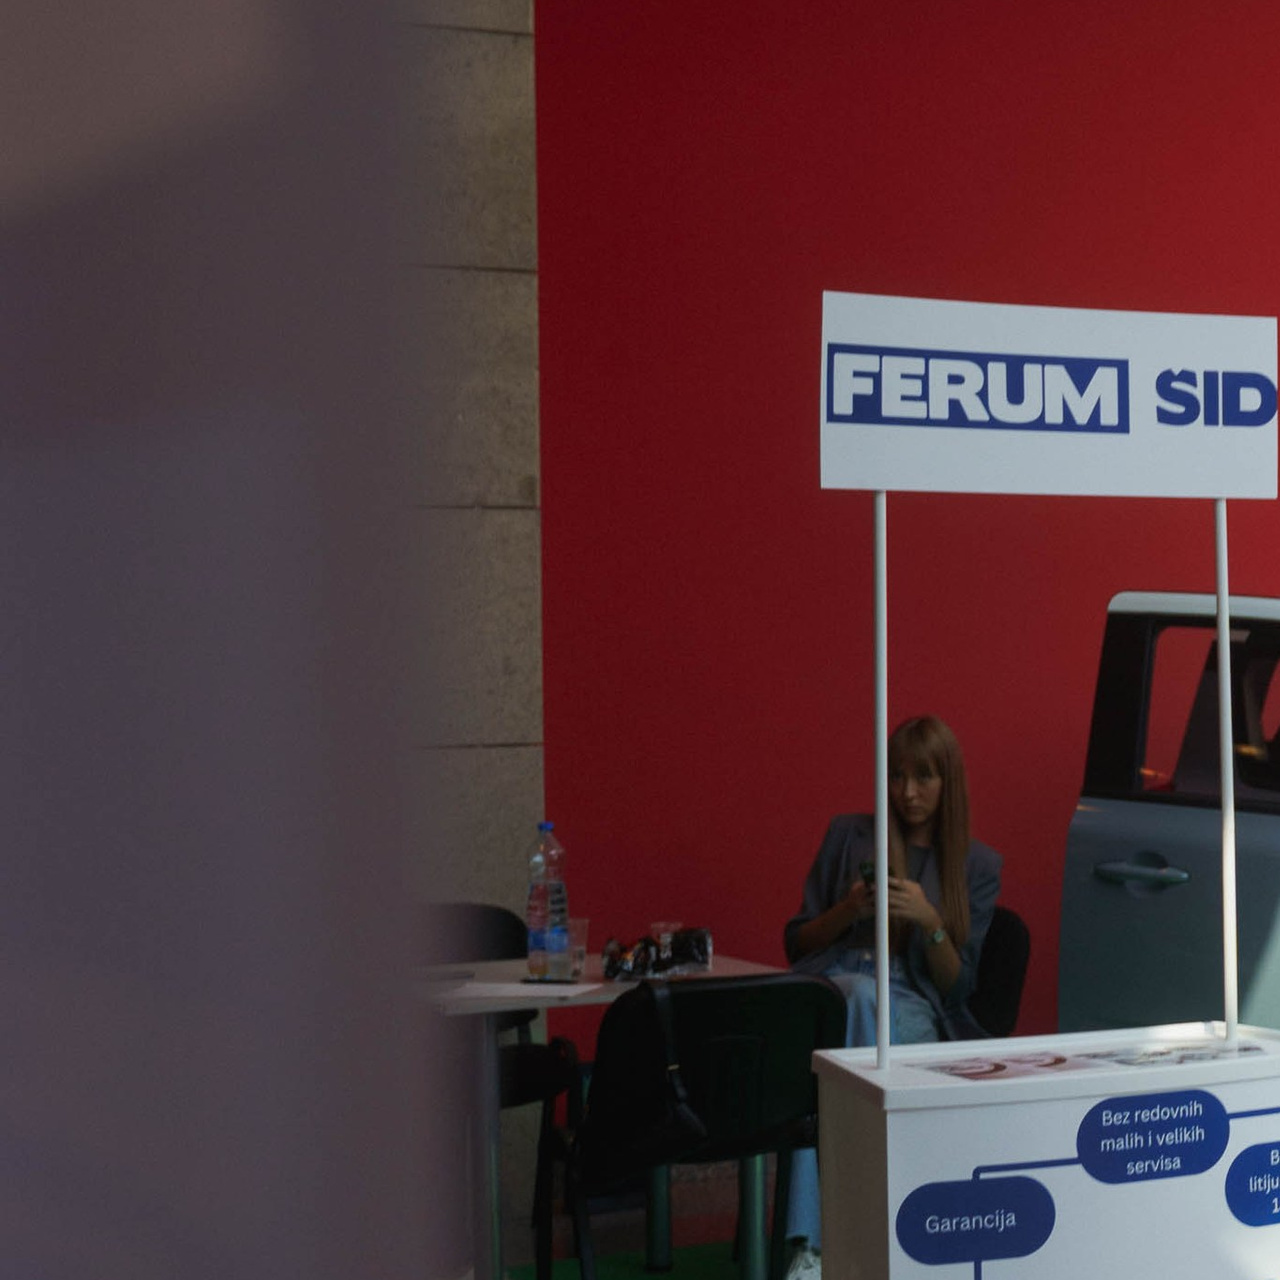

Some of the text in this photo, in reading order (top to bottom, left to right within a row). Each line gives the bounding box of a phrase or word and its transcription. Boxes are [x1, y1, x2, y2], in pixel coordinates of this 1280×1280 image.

[832, 352, 1119, 426] FERUM
[1101, 1100, 1203, 1127] Bez redovnih
[1100, 1125, 1205, 1152] malih i velikih
[1126, 1154, 1182, 1176] servisa
[925, 1208, 1017, 1234] Garancija
